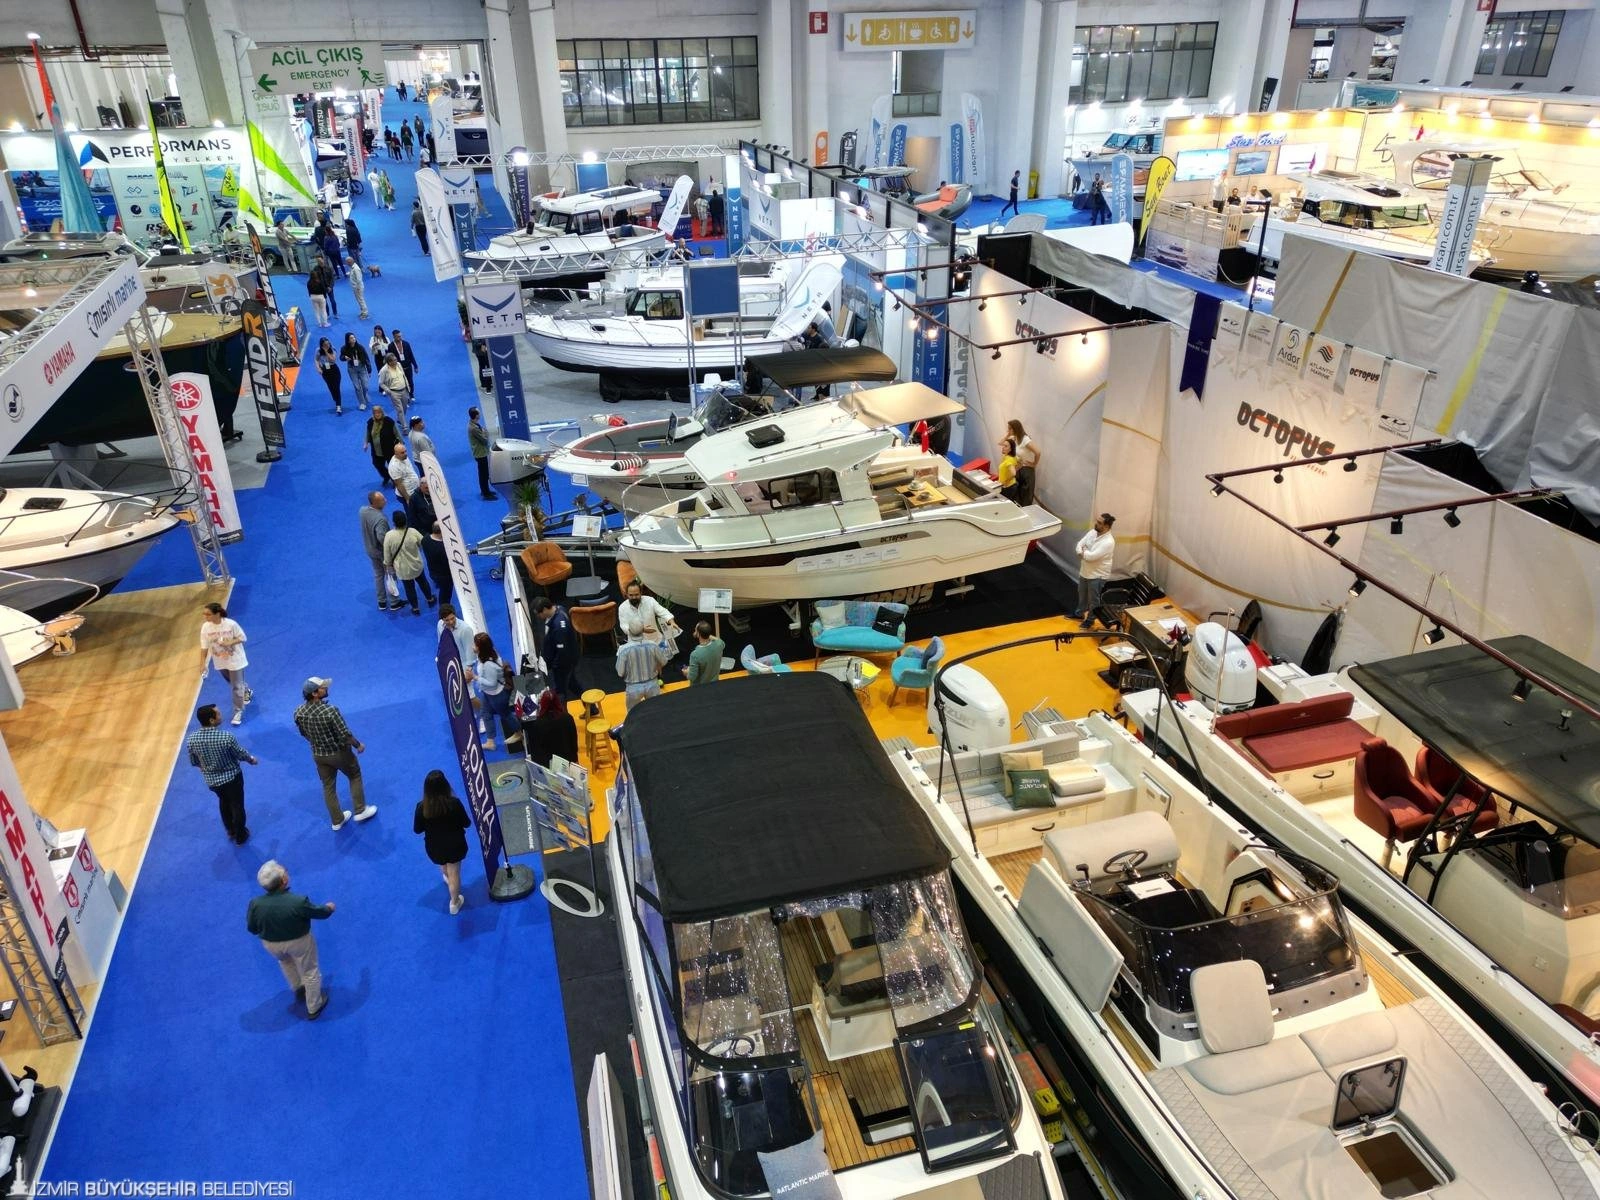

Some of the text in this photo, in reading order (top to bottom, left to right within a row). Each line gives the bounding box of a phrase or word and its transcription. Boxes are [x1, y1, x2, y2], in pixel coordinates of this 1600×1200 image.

[271, 46, 364, 67] ACİL ÇIKIŞ
[290, 69, 350, 90] EMERGENCY EXIT
[173, 155, 234, 164] YELKEN
[471, 312, 524, 326] NETA
[50, 340, 77, 379] YAMAHA
[1277, 347, 1301, 365] Ardor
[1349, 367, 1381, 382] OCTOPUS
[500, 363, 519, 420] NETA
[1236, 400, 1336, 466] OCTOPUS
[181, 414, 225, 529] YAMAHA
[880, 532, 909, 544] OCTOPUS
[780, 1177, 808, 1194] ATLANTIC
